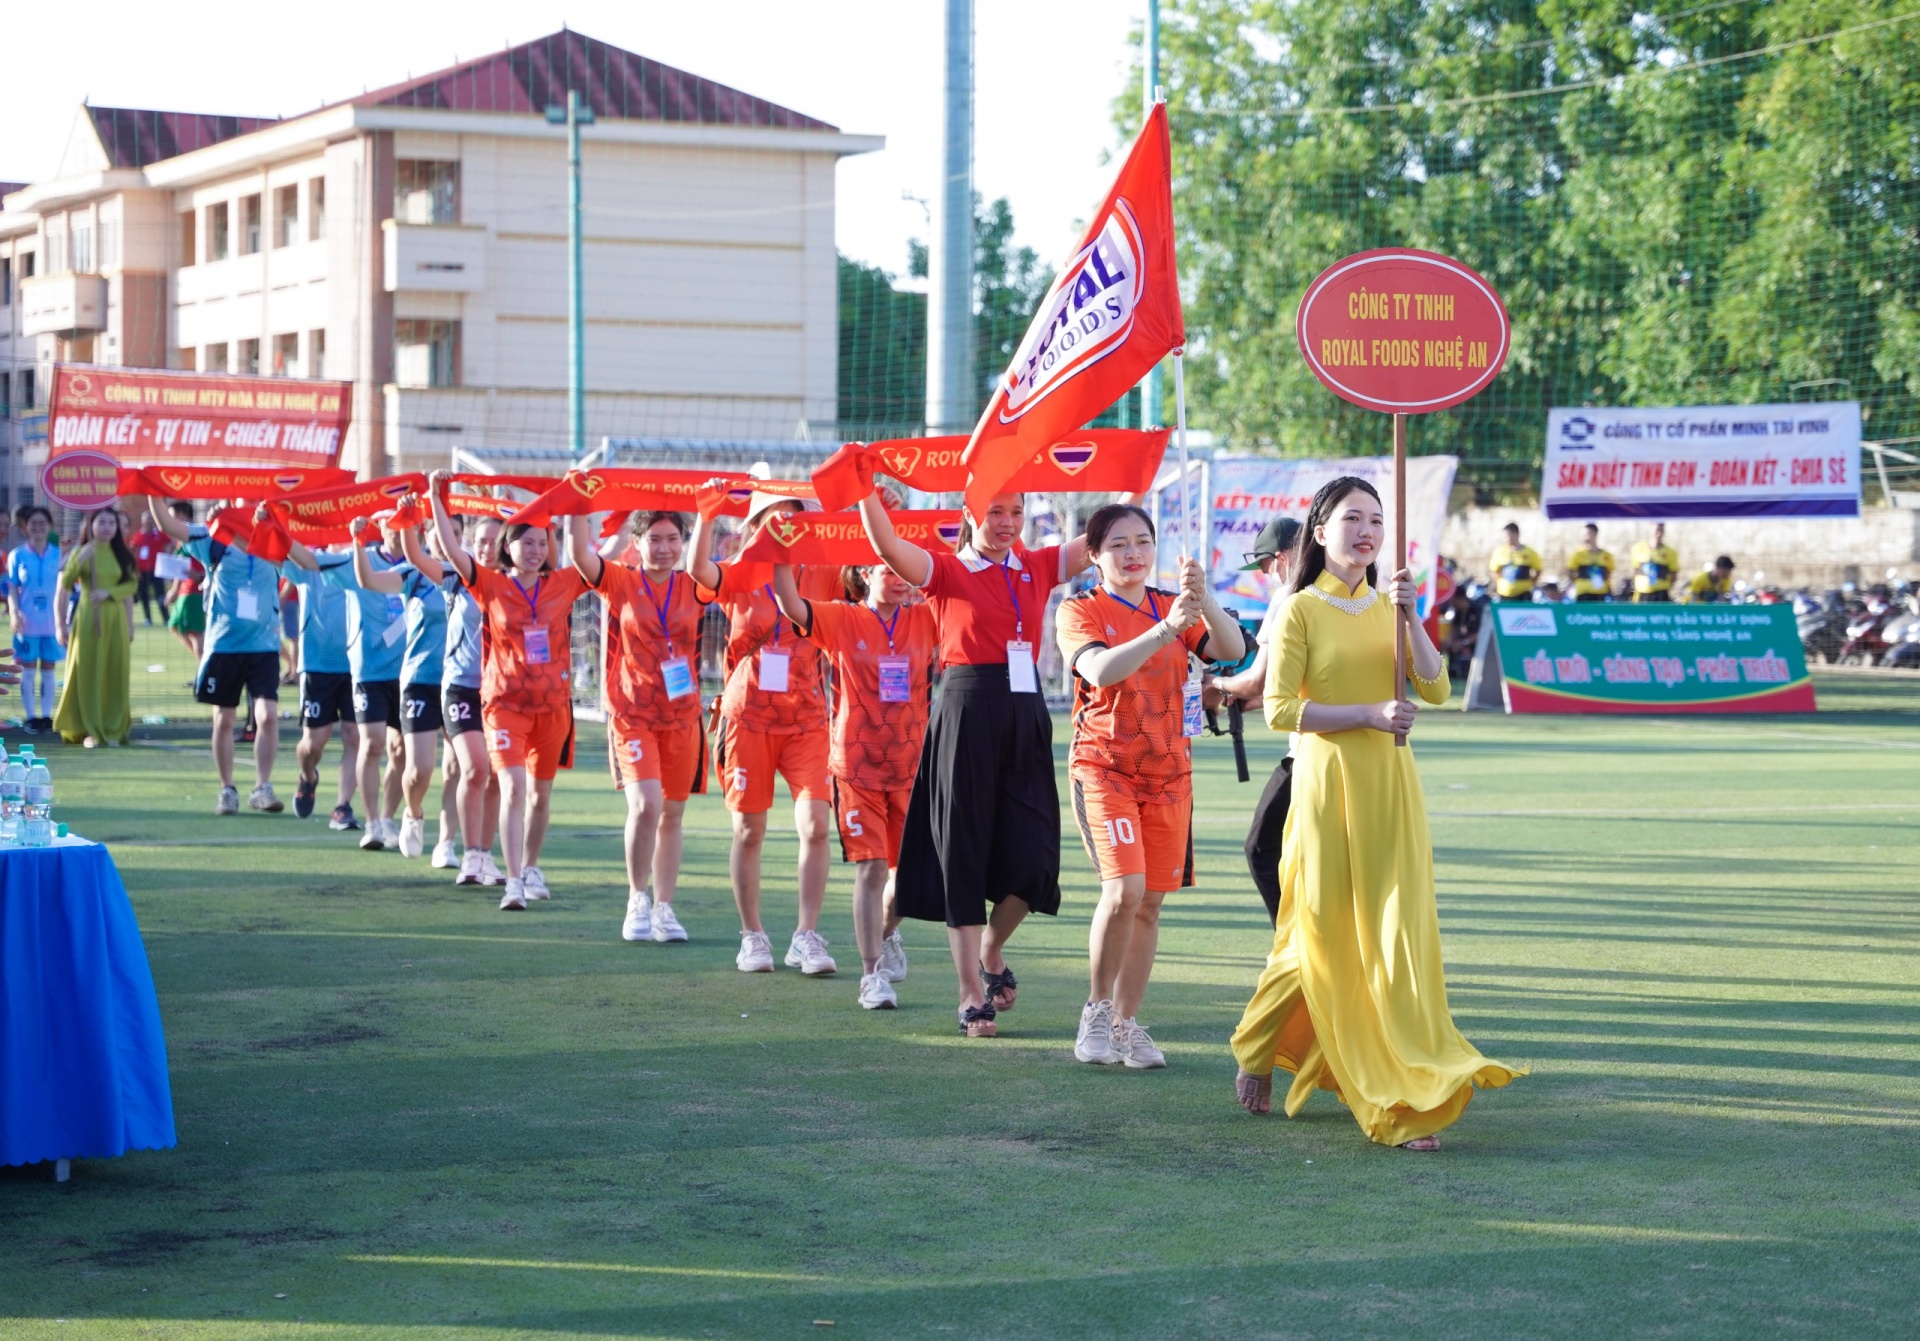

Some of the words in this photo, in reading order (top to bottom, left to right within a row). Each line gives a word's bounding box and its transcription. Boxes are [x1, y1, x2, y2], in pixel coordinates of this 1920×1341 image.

[1349, 287, 1389, 320] CÔNG
[1393, 294, 1411, 320] TY
[1415, 294, 1455, 321] TNHH
[1322, 339, 1368, 367] ROYAL
[1372, 339, 1419, 367] FOODS
[1424, 335, 1464, 370] NGHỆ
[1468, 341, 1488, 368] AN
[104, 382, 141, 403] CÔNG
[143, 386, 160, 404] TY
[161, 387, 196, 406] TNHH
[198, 389, 227, 407] MTV
[256, 391, 283, 409] SEN
[320, 395, 341, 412] AN
[105, 413, 142, 445] KẾT
[154, 416, 181, 452] TỰ
[181, 419, 212, 446] TIN
[224, 418, 280, 449] CHIẾN
[281, 418, 341, 455] THẮNG
[1603, 422, 1643, 439] CÔNG
[1647, 422, 1662, 438] TY
[926, 450, 966, 468] ROY
[1558, 456, 1588, 488] SẢN
[1589, 455, 1628, 488] XUẤT
[1629, 461, 1664, 488] TINH
[1751, 452, 1779, 486] KẾT
[1790, 458, 1824, 485] CHIA
[80, 466, 90, 479] TY
[194, 474, 231, 486] ROYAL
[233, 474, 271, 487] FOODS
[297, 498, 337, 517] ROYAL
[338, 491, 379, 512] FOODS
[814, 523, 867, 540] ROYAL
[892, 523, 928, 539] ODS
[1603, 652, 1651, 684] SÁNG
[1650, 656, 1685, 688] TẠO
[1695, 652, 1740, 684] PHÁT
[206, 677, 217, 695] 5
[304, 701, 321, 718] 20
[406, 699, 427, 719] 27
[448, 702, 472, 723] 92
[628, 739, 643, 763] 3
[846, 810, 863, 837] 5
[1103, 817, 1136, 847] 10
